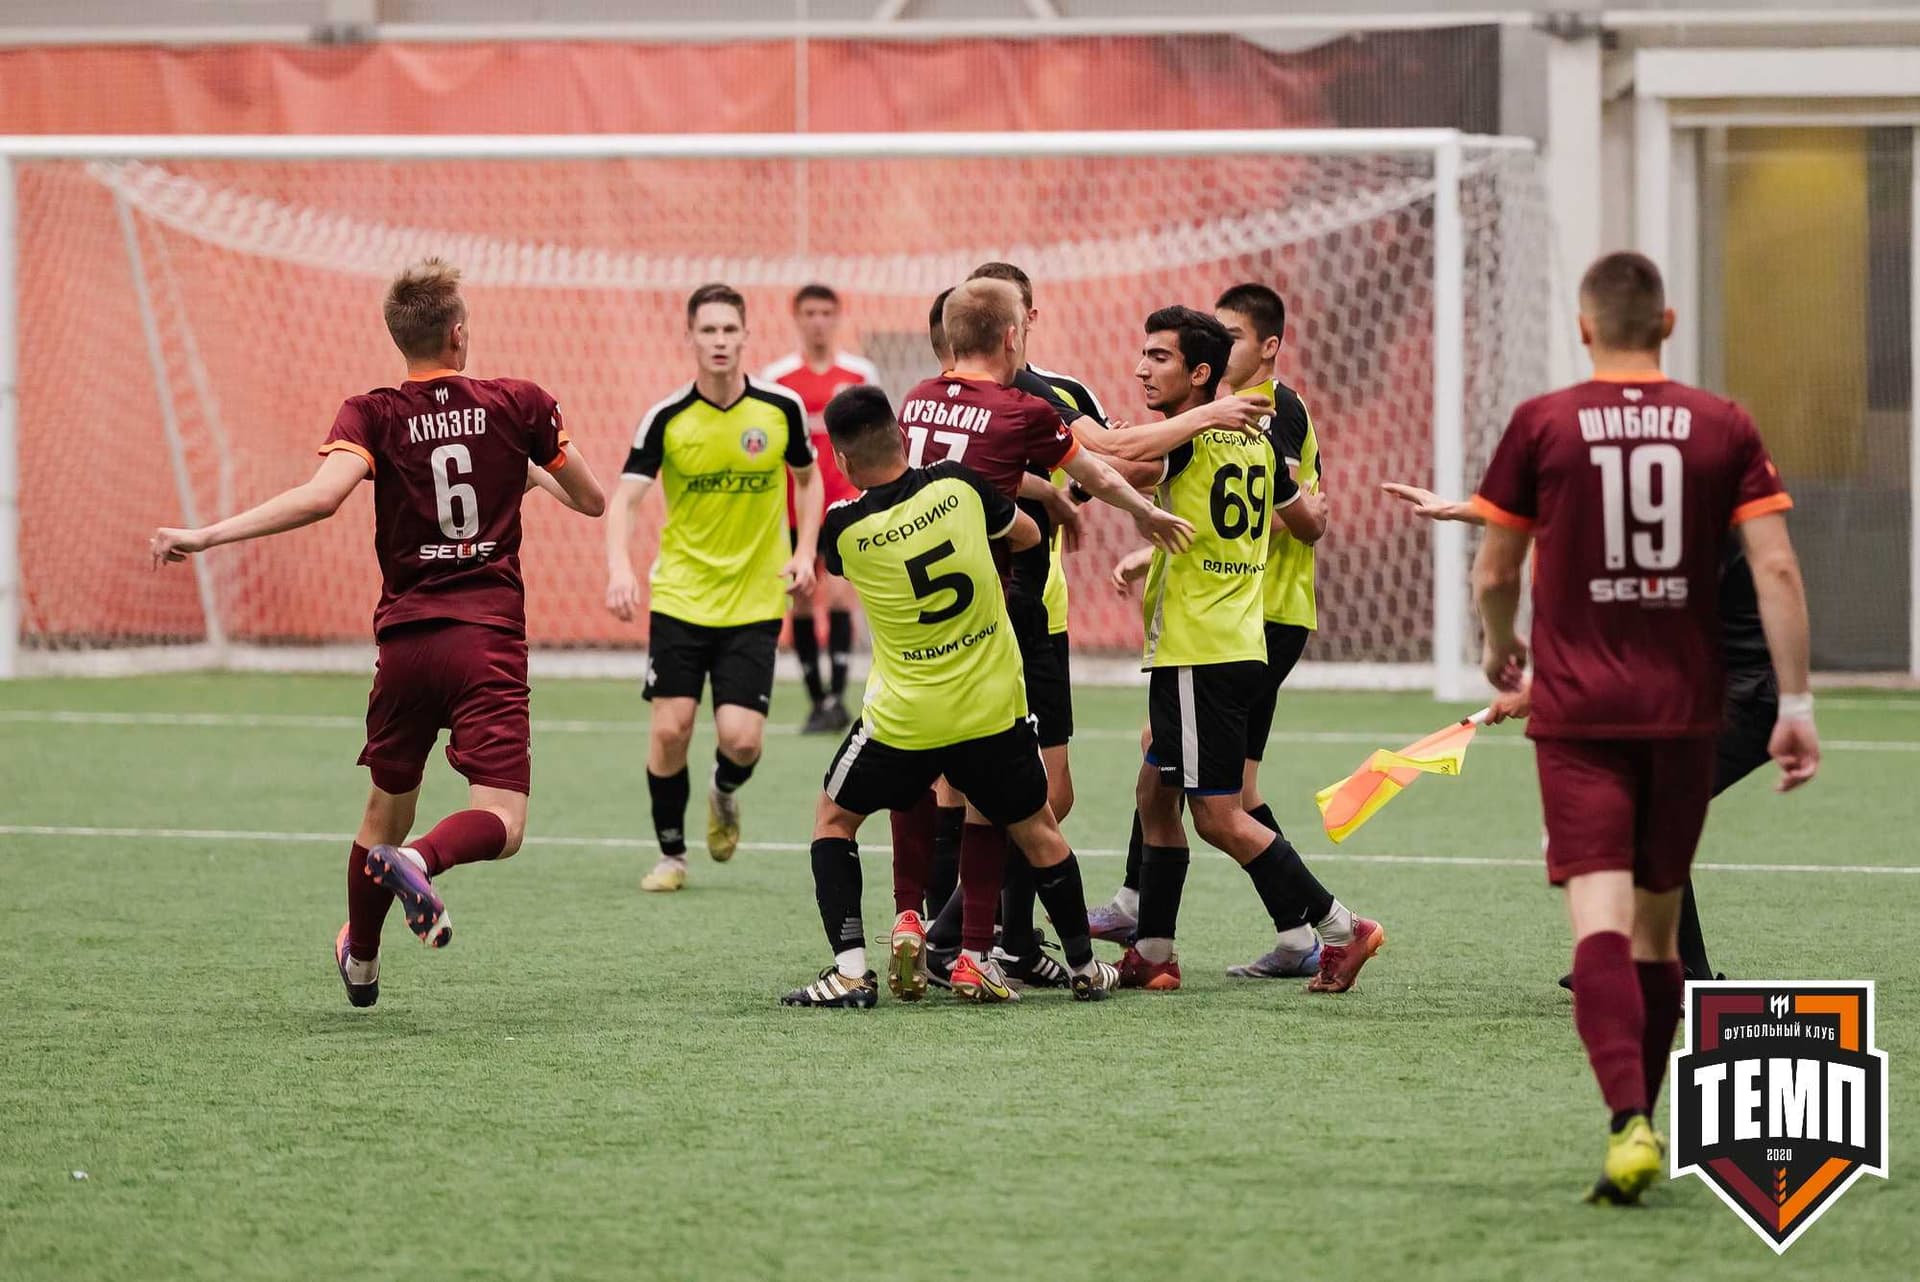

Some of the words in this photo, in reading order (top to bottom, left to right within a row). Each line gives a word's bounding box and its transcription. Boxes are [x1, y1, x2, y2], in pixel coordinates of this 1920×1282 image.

[408, 408, 487, 443] КНЯЗЕВ
[903, 399, 992, 434] КУЗЬКИН
[1578, 405, 1692, 442] ШИБАЕВ
[908, 426, 969, 469] 17
[430, 444, 480, 540] 6
[1210, 463, 1266, 541] 69
[1589, 444, 1683, 571] 19
[419, 541, 497, 560] SEUS
[904, 539, 975, 625] 5
[1589, 576, 1688, 602] SEUS
[926, 641, 959, 659] RVM
